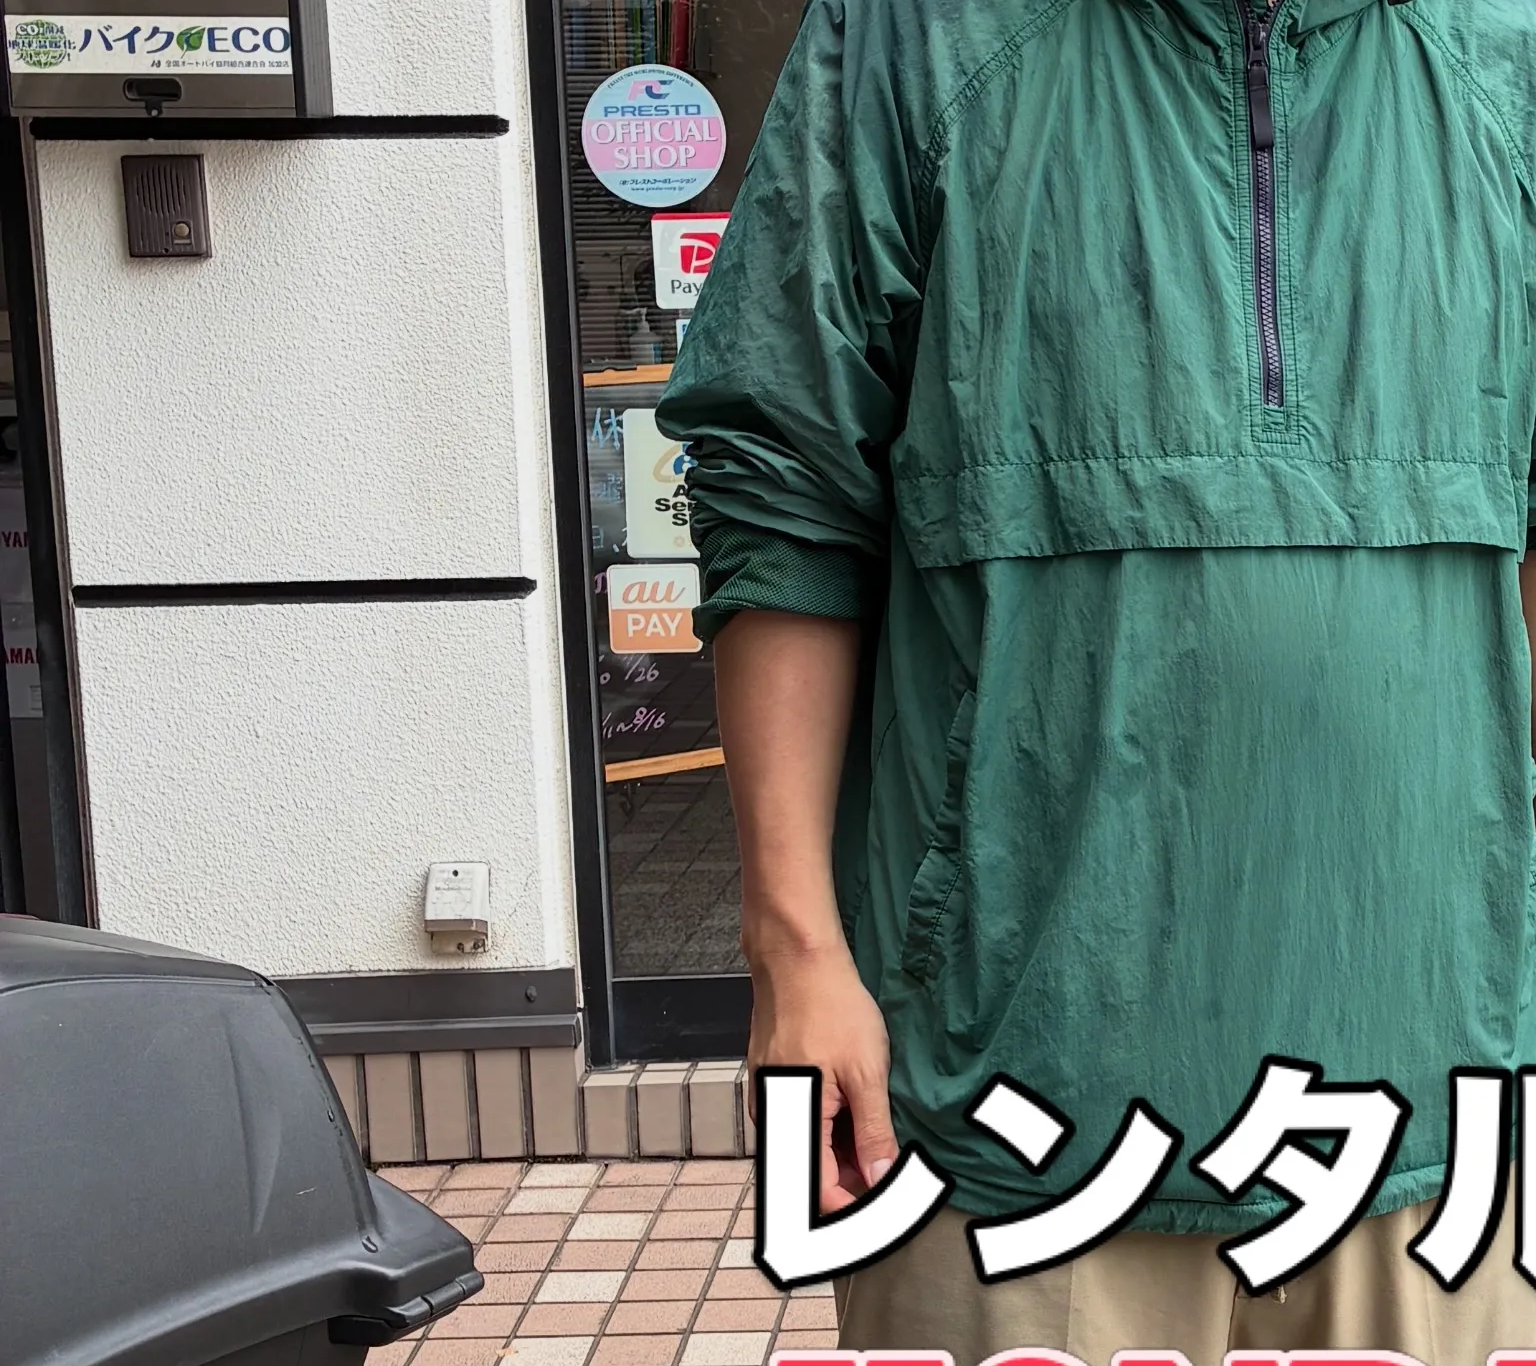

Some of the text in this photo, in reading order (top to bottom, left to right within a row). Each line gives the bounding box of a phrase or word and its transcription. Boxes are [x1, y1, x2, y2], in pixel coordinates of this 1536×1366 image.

[77, 25, 292, 54] バイク ECO
[603, 104, 701, 117] PRESTO
[590, 119, 718, 145] OFFICIAL
[613, 144, 697, 170] SHOP
[671, 279, 703, 297] Pay
[622, 580, 686, 604] au
[627, 611, 684, 638] PAY
